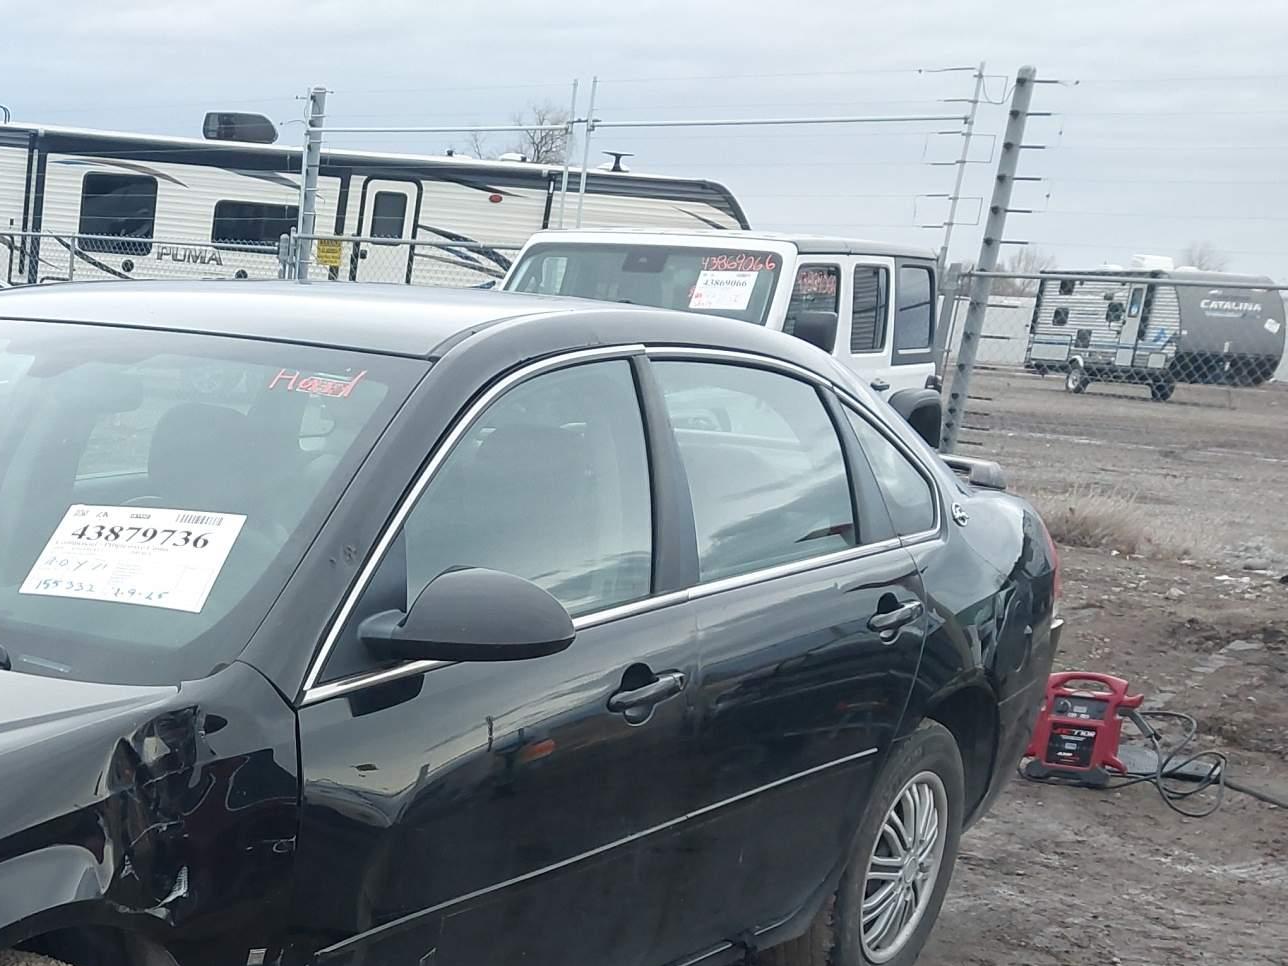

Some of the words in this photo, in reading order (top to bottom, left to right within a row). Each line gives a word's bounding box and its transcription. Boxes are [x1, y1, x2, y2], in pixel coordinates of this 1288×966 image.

[156, 245, 223, 266] PUMA
[701, 253, 777, 272] 43869066
[1199, 299, 1262, 312] CATALINA
[71, 523, 213, 549] 43879736
